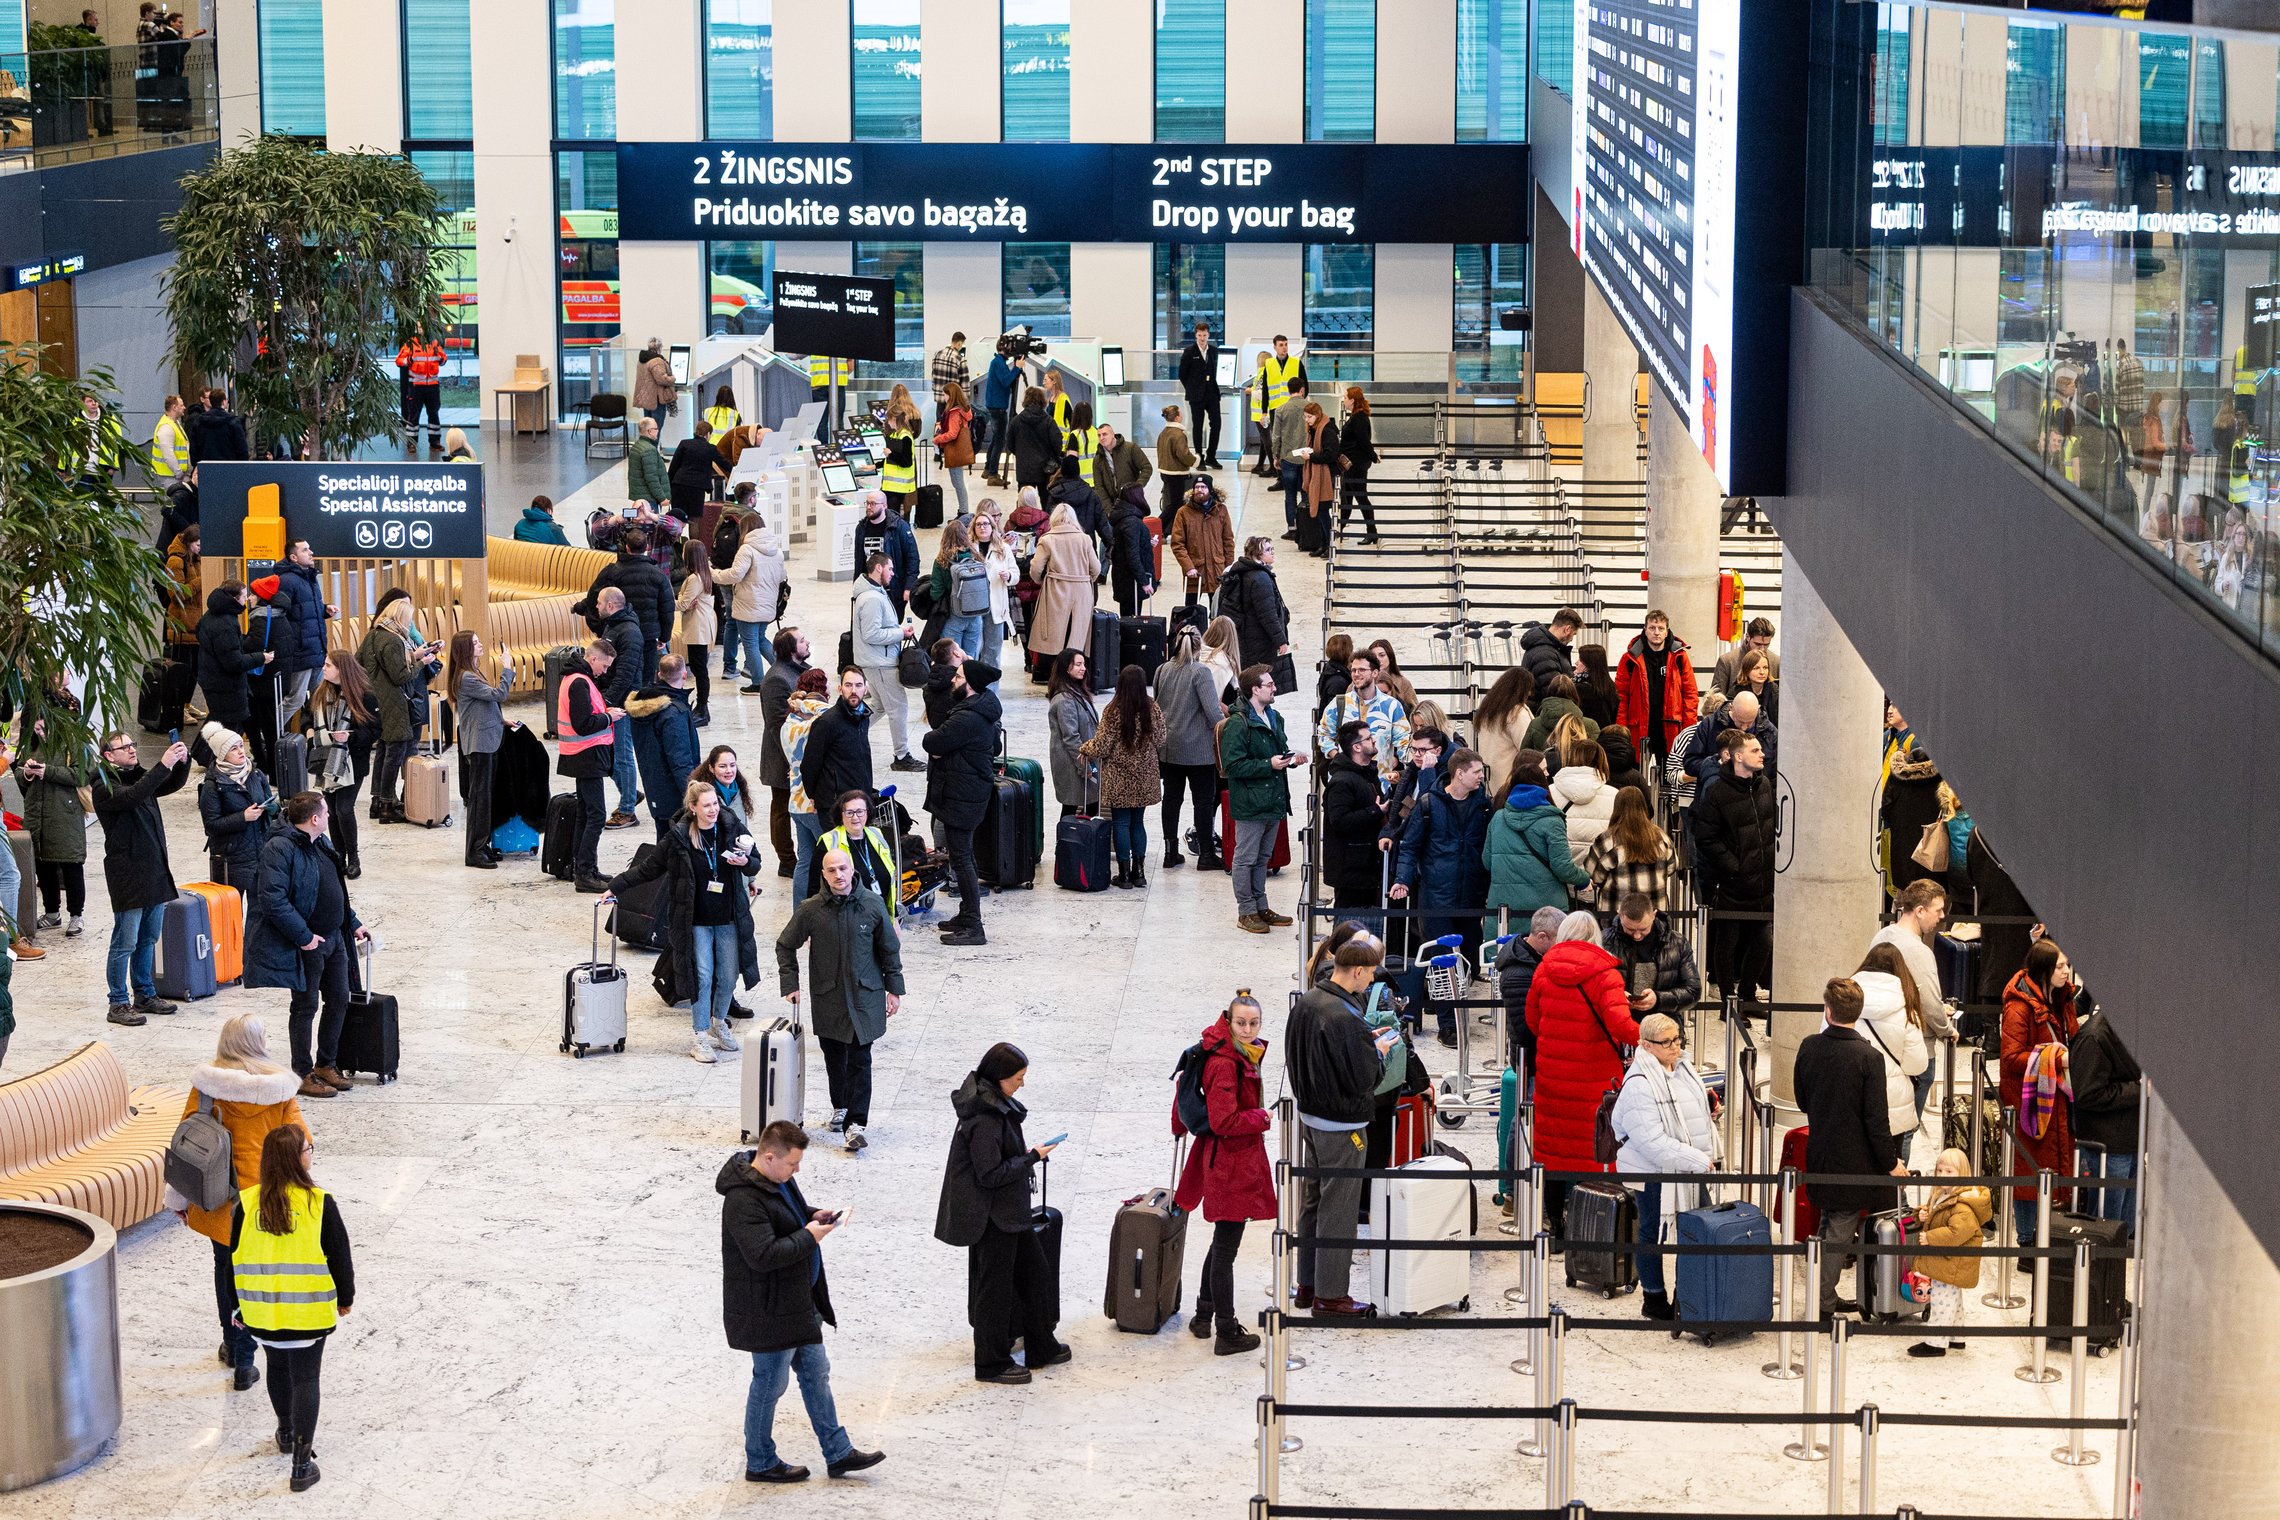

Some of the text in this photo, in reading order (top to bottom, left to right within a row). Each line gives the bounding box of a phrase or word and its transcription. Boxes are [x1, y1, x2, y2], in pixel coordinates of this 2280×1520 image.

[692, 150, 853, 185] 2 ŽINGSNIS
[1152, 155, 1272, 186] 2nd STEP
[603, 218, 618, 232] 083
[693, 197, 1028, 234] Priduokite savo bagažą
[1152, 199, 1355, 235] Drop your bag
[562, 295, 606, 304] PAGALBA
[779, 281, 817, 298] 1 ŽINGSNIS
[855, 289, 873, 302] STEP
[318, 474, 467, 495] Specialioji pagalba
[319, 496, 467, 515] Special Assistance
